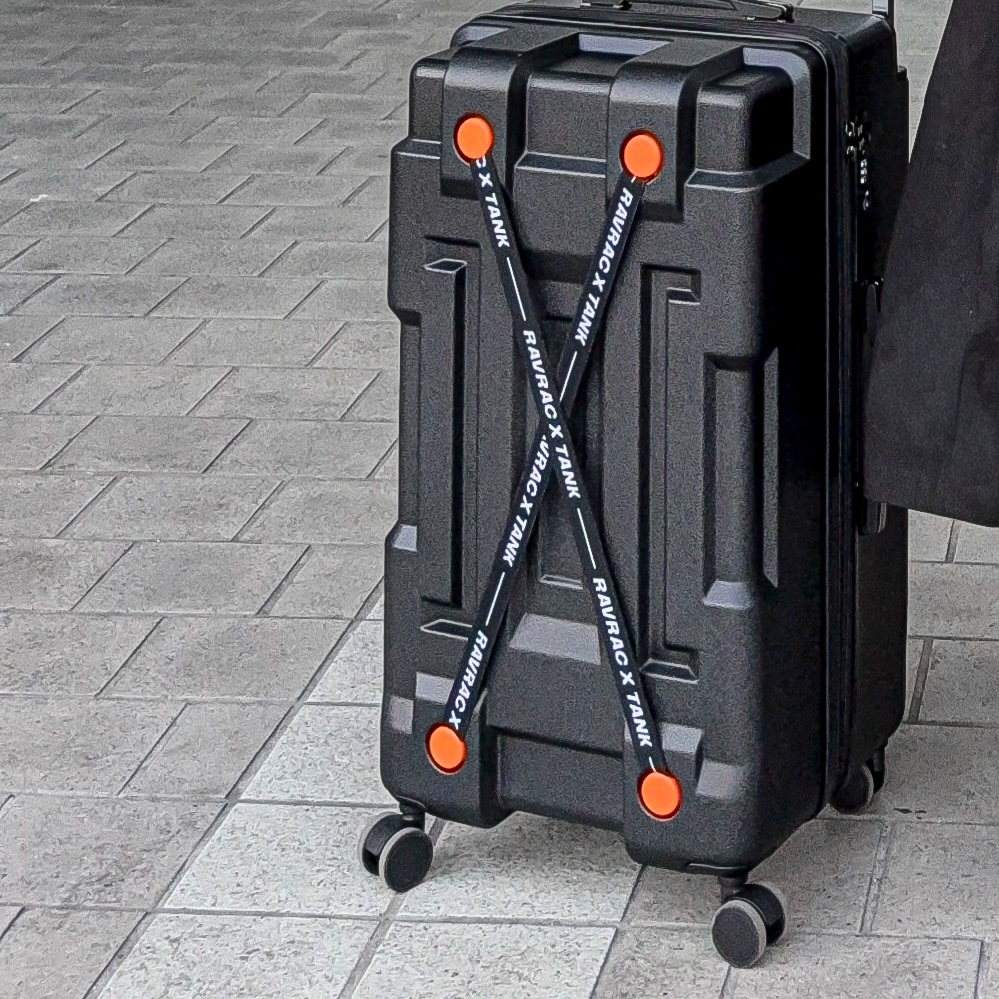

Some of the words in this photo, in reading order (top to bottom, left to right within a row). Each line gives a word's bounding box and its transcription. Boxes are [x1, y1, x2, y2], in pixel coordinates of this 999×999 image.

[478, 172, 494, 188] X
[484, 192, 511, 248] TANK
[598, 187, 634, 273] RAVRAC
[592, 272, 606, 292] X
[574, 293, 600, 346] TANK
[522, 329, 558, 420] RAVRAC
[548, 423, 564, 439] X
[525, 434, 550, 497] VRAC
[554, 443, 581, 499] TANK
[519, 494, 533, 515] X
[502, 514, 528, 567] TANK
[592, 577, 629, 666] RAVRAC
[455, 630, 488, 712] RAVRAC
[619, 670, 636, 686] X
[448, 710, 462, 730] X
[626, 692, 652, 747] TANK
